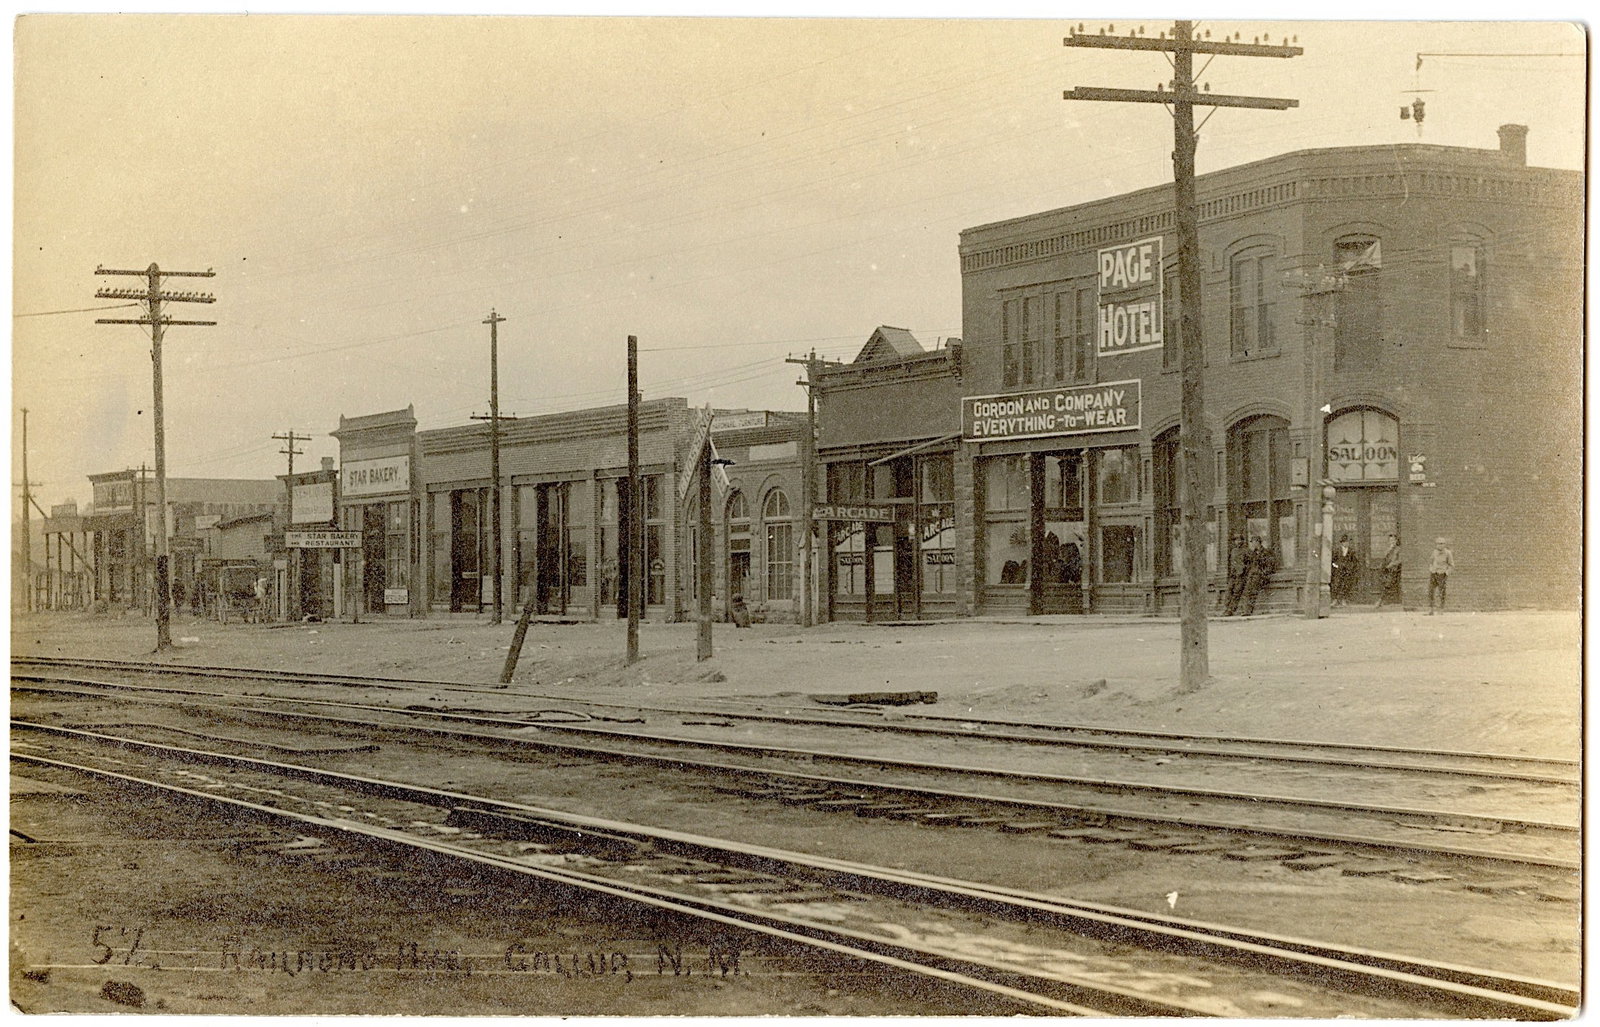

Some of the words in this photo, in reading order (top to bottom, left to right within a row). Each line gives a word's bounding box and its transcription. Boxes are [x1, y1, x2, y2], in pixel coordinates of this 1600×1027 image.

[1101, 245, 1153, 288] PAGE
[1100, 301, 1162, 348] HOTEL
[973, 398, 1024, 418] GORDON
[1025, 397, 1050, 413] AND
[1054, 389, 1125, 411] COMPANY
[1329, 446, 1397, 462] SALOON
[349, 470, 367, 487] STAR
[825, 506, 889, 520] ARCADE
[923, 517, 955, 540] ARCADE
